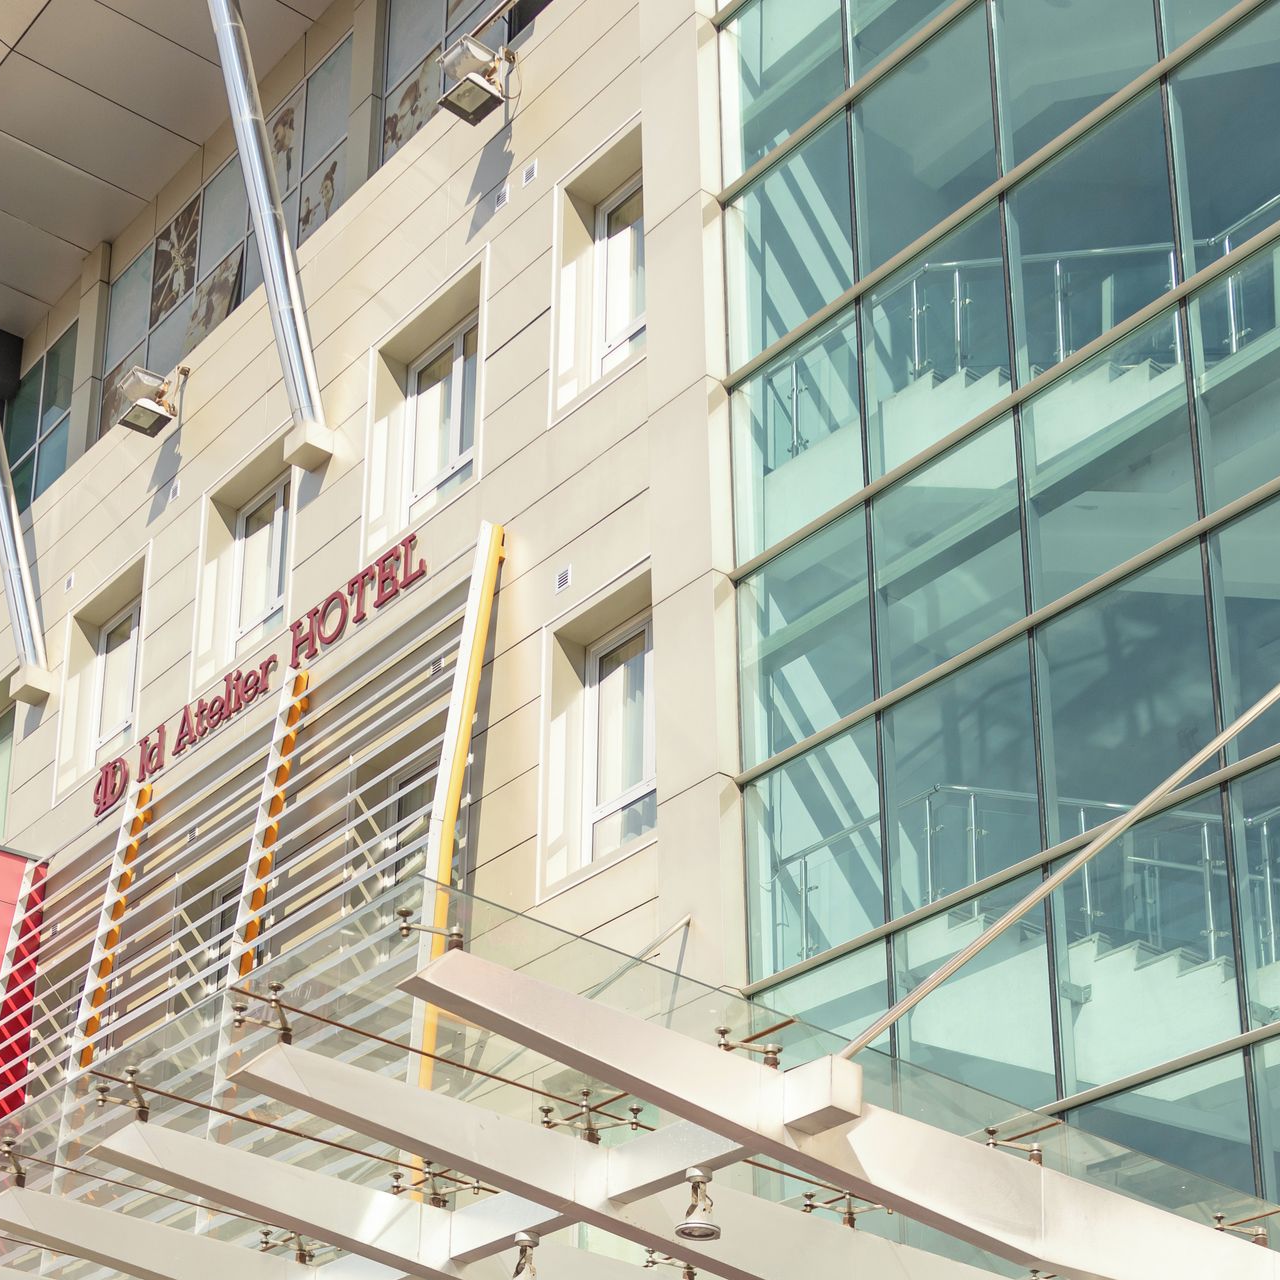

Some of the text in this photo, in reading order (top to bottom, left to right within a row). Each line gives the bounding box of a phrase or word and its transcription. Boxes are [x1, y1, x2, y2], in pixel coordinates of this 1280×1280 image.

[137, 723, 166, 784] Id
[172, 653, 278, 757] Atelier
[289, 532, 427, 668] HOTEL
